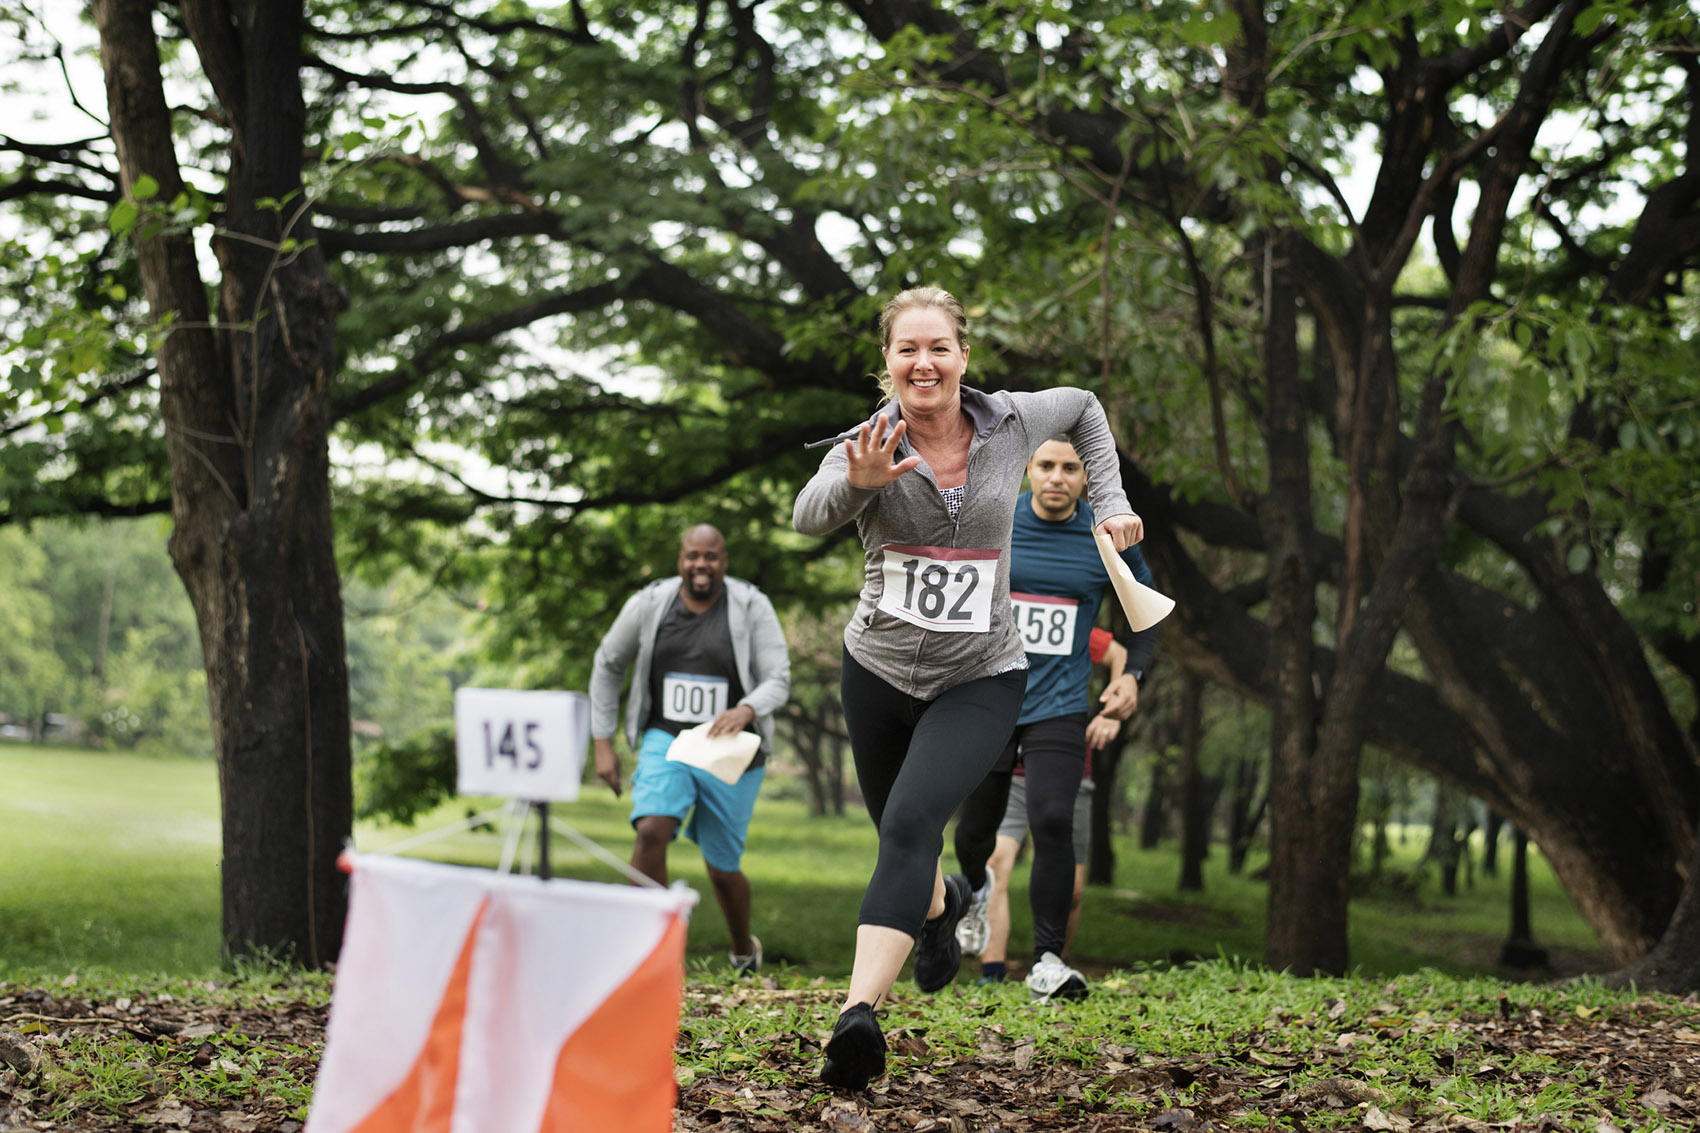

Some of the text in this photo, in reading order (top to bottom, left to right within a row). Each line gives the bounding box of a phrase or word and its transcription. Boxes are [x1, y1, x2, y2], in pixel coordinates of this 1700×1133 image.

[902, 559, 980, 620] 182
[673, 684, 717, 715] 001
[481, 719, 544, 771] 145
